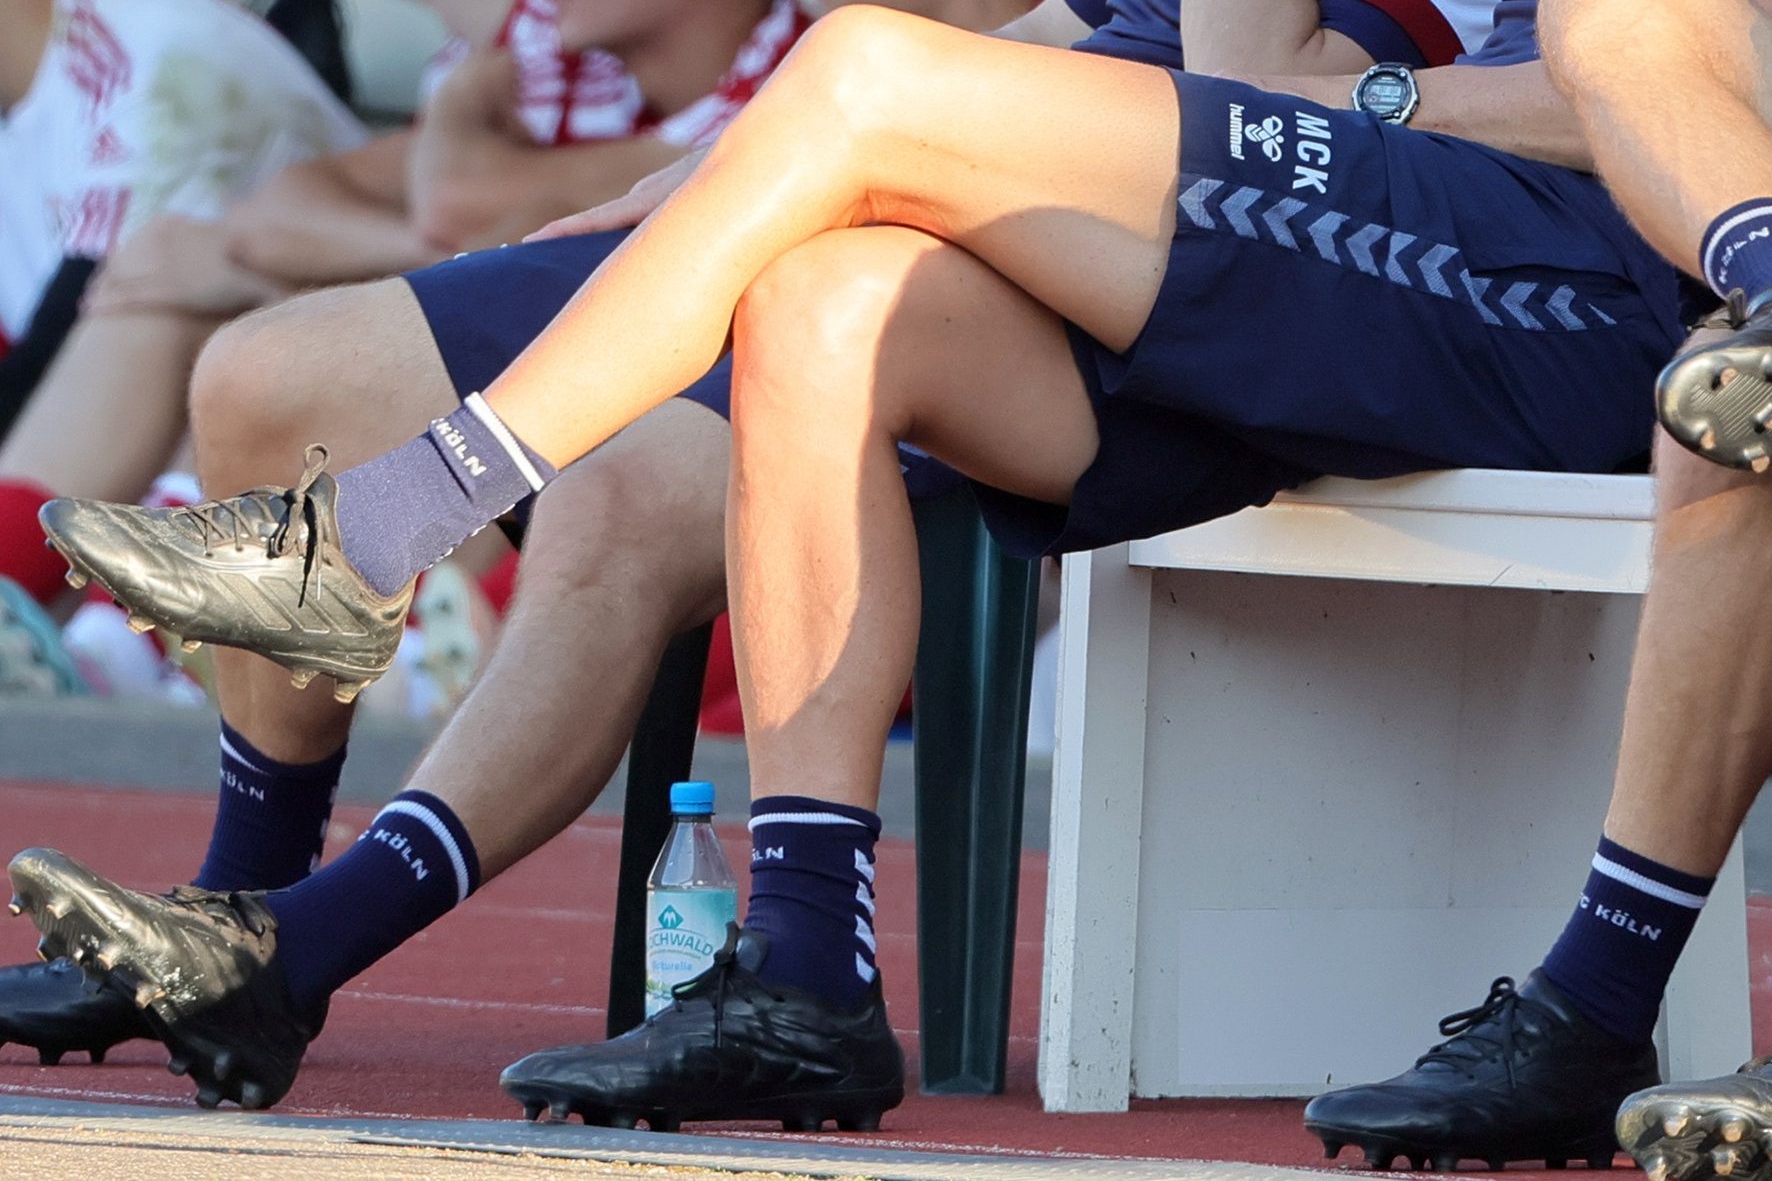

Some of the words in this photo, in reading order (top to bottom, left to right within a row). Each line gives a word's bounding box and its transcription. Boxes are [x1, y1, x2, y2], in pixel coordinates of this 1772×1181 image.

[1229, 103, 1245, 161] hummel
[1292, 110, 1332, 195] MCK
[1595, 904, 1662, 941] KÖLN
